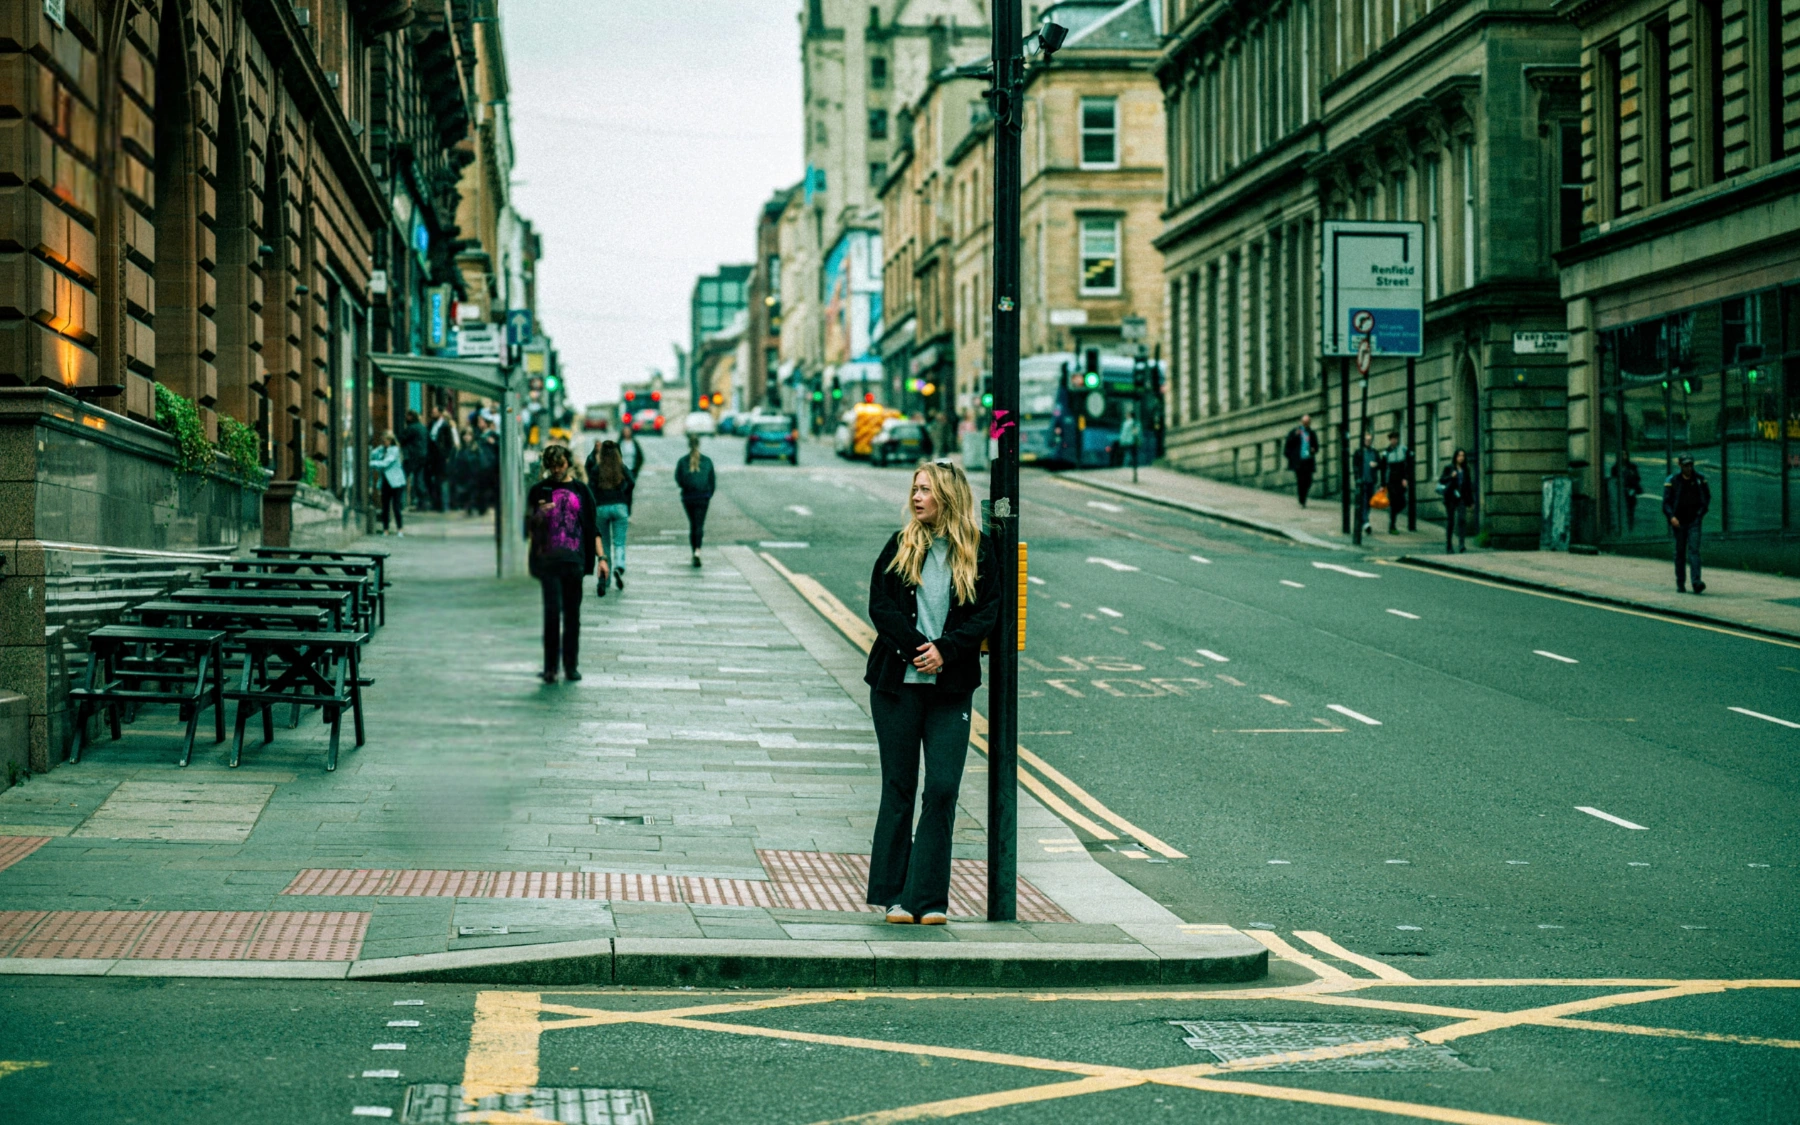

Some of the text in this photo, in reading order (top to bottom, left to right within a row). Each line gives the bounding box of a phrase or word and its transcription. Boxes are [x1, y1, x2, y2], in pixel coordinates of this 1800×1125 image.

[1371, 264, 1415, 275] Renfield
[1376, 276, 1410, 287] Street
[1018, 656, 1146, 671] US
